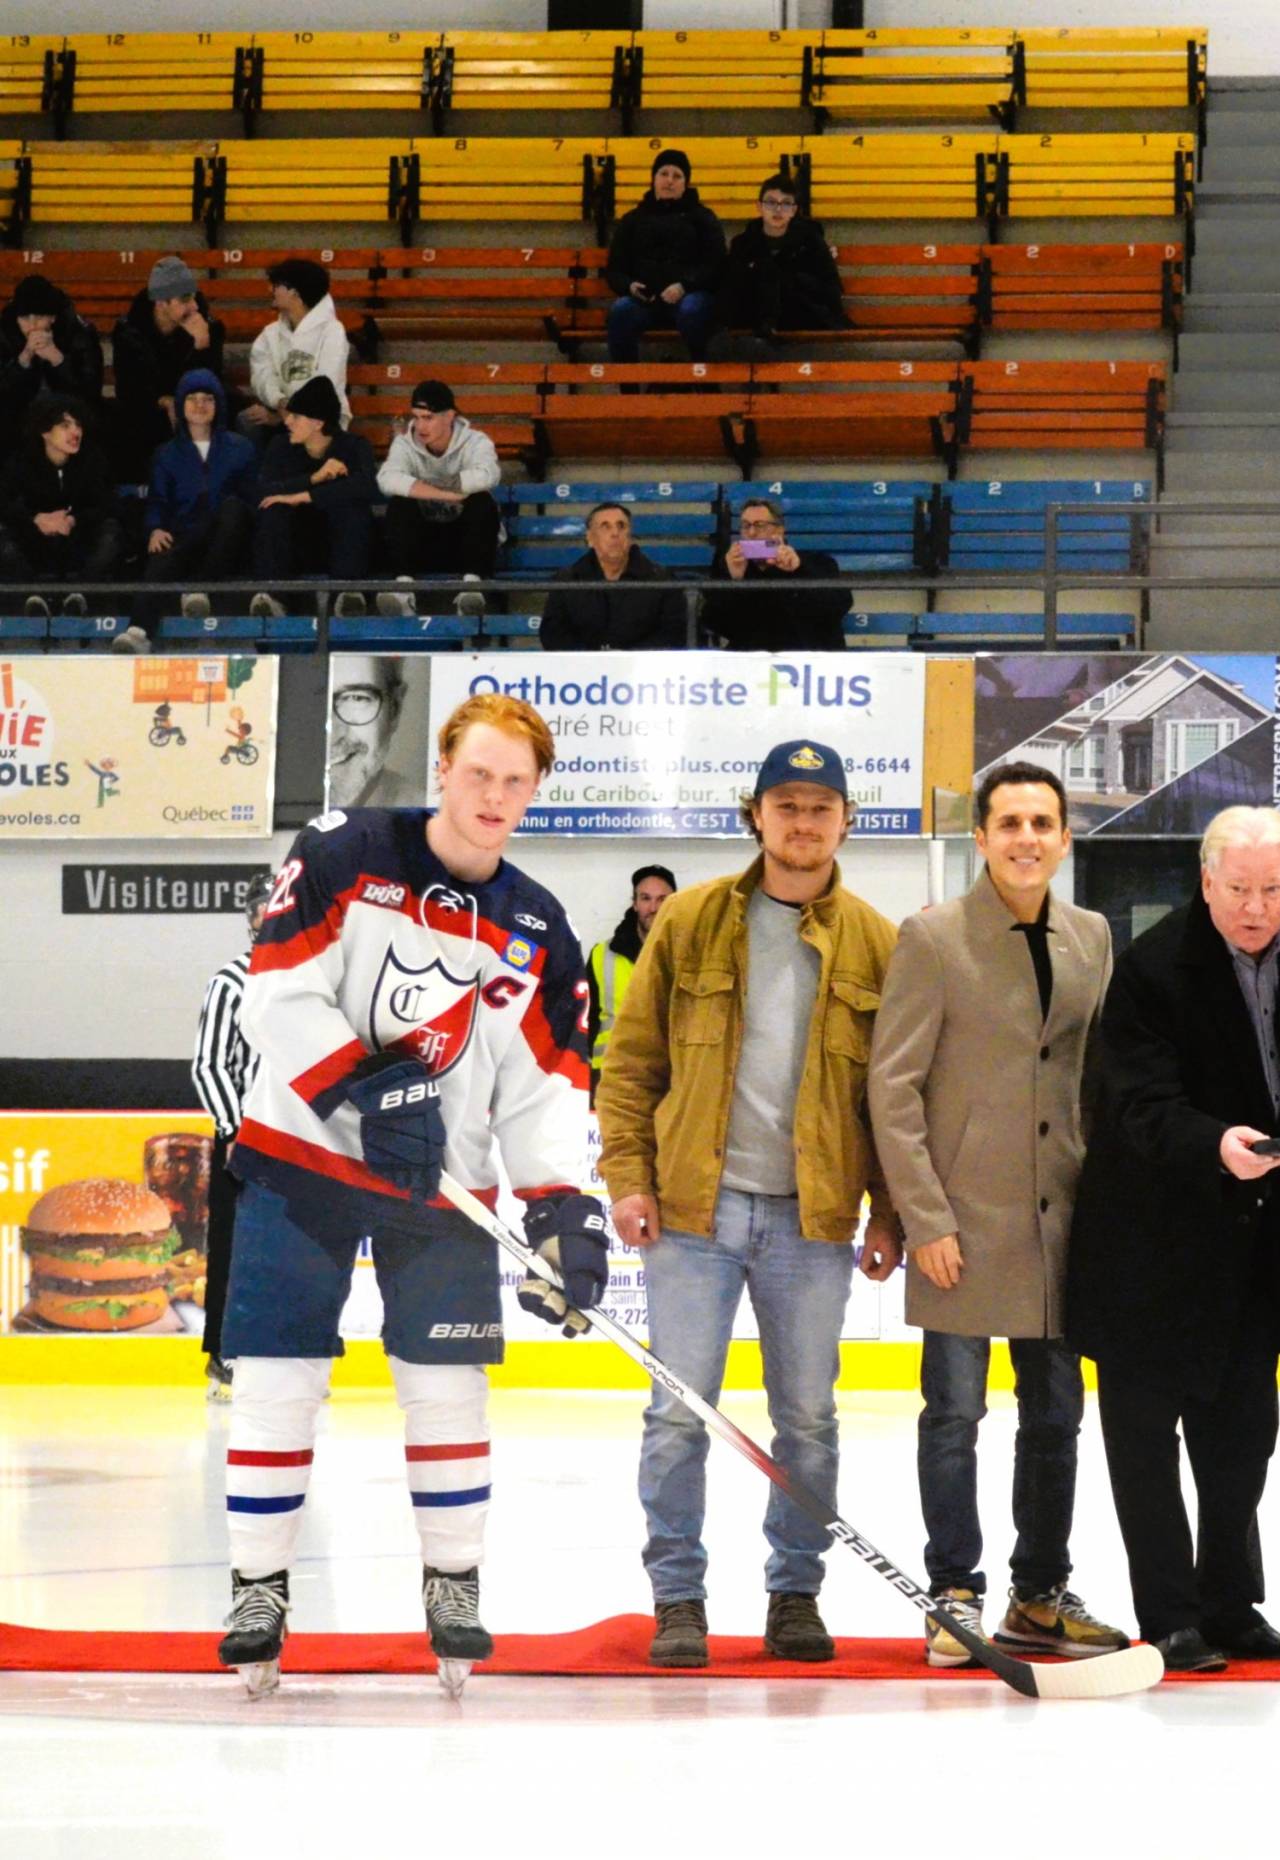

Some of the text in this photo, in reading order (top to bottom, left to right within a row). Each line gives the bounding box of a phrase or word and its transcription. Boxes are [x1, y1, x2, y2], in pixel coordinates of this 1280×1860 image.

[10, 35, 30, 47] 13
[105, 34, 124, 46] 12
[197, 33, 212, 45] 11
[293, 32, 313, 44] 10
[389, 32, 400, 44] 9
[675, 31, 687, 43] 6
[769, 31, 780, 43] 5
[456, 139, 467, 151] 8
[553, 138, 564, 151] 7
[649, 138, 661, 151] 6
[746, 138, 759, 150] 5
[852, 136, 864, 149] 4
[941, 136, 953, 148] 3
[1040, 135, 1052, 148] 2
[23, 251, 44, 264] 12
[120, 251, 135, 264] 11
[223, 250, 243, 263] 10
[321, 250, 334, 263] 9
[521, 249, 534, 263] 7
[923, 245, 937, 259] 3
[1027, 245, 1039, 259] 2
[1128, 245, 1135, 258] 1
[387, 361, 1116, 378] 8 7 6 5 4 3 2 1
[556, 484, 570, 498] 6
[658, 482, 672, 496] 5
[769, 482, 782, 496] 4
[873, 482, 887, 495] 3
[988, 481, 1001, 495] 2
[1094, 481, 1101, 495] 1
[95, 617, 116, 631] 10
[204, 617, 218, 631] 9
[419, 617, 432, 631] 7
[855, 613, 868, 628] 3
[469, 664, 872, 708] Orthodontiste Plus
[549, 714, 590, 737] dré
[844, 757, 911, 773] 8-6644
[0, 762, 70, 787] OLES
[550, 784, 574, 802] du
[847, 786, 883, 803] euil
[0, 811, 81, 826] evoles.ca
[162, 805, 229, 823] Québec
[519, 816, 548, 828] nnu
[554, 816, 573, 828] en
[682, 812, 729, 829] C'EST
[855, 812, 908, 830] TISTE!
[84, 869, 250, 909] Visiteurs
[266, 860, 303, 913] 22
[480, 974, 528, 1010] C
